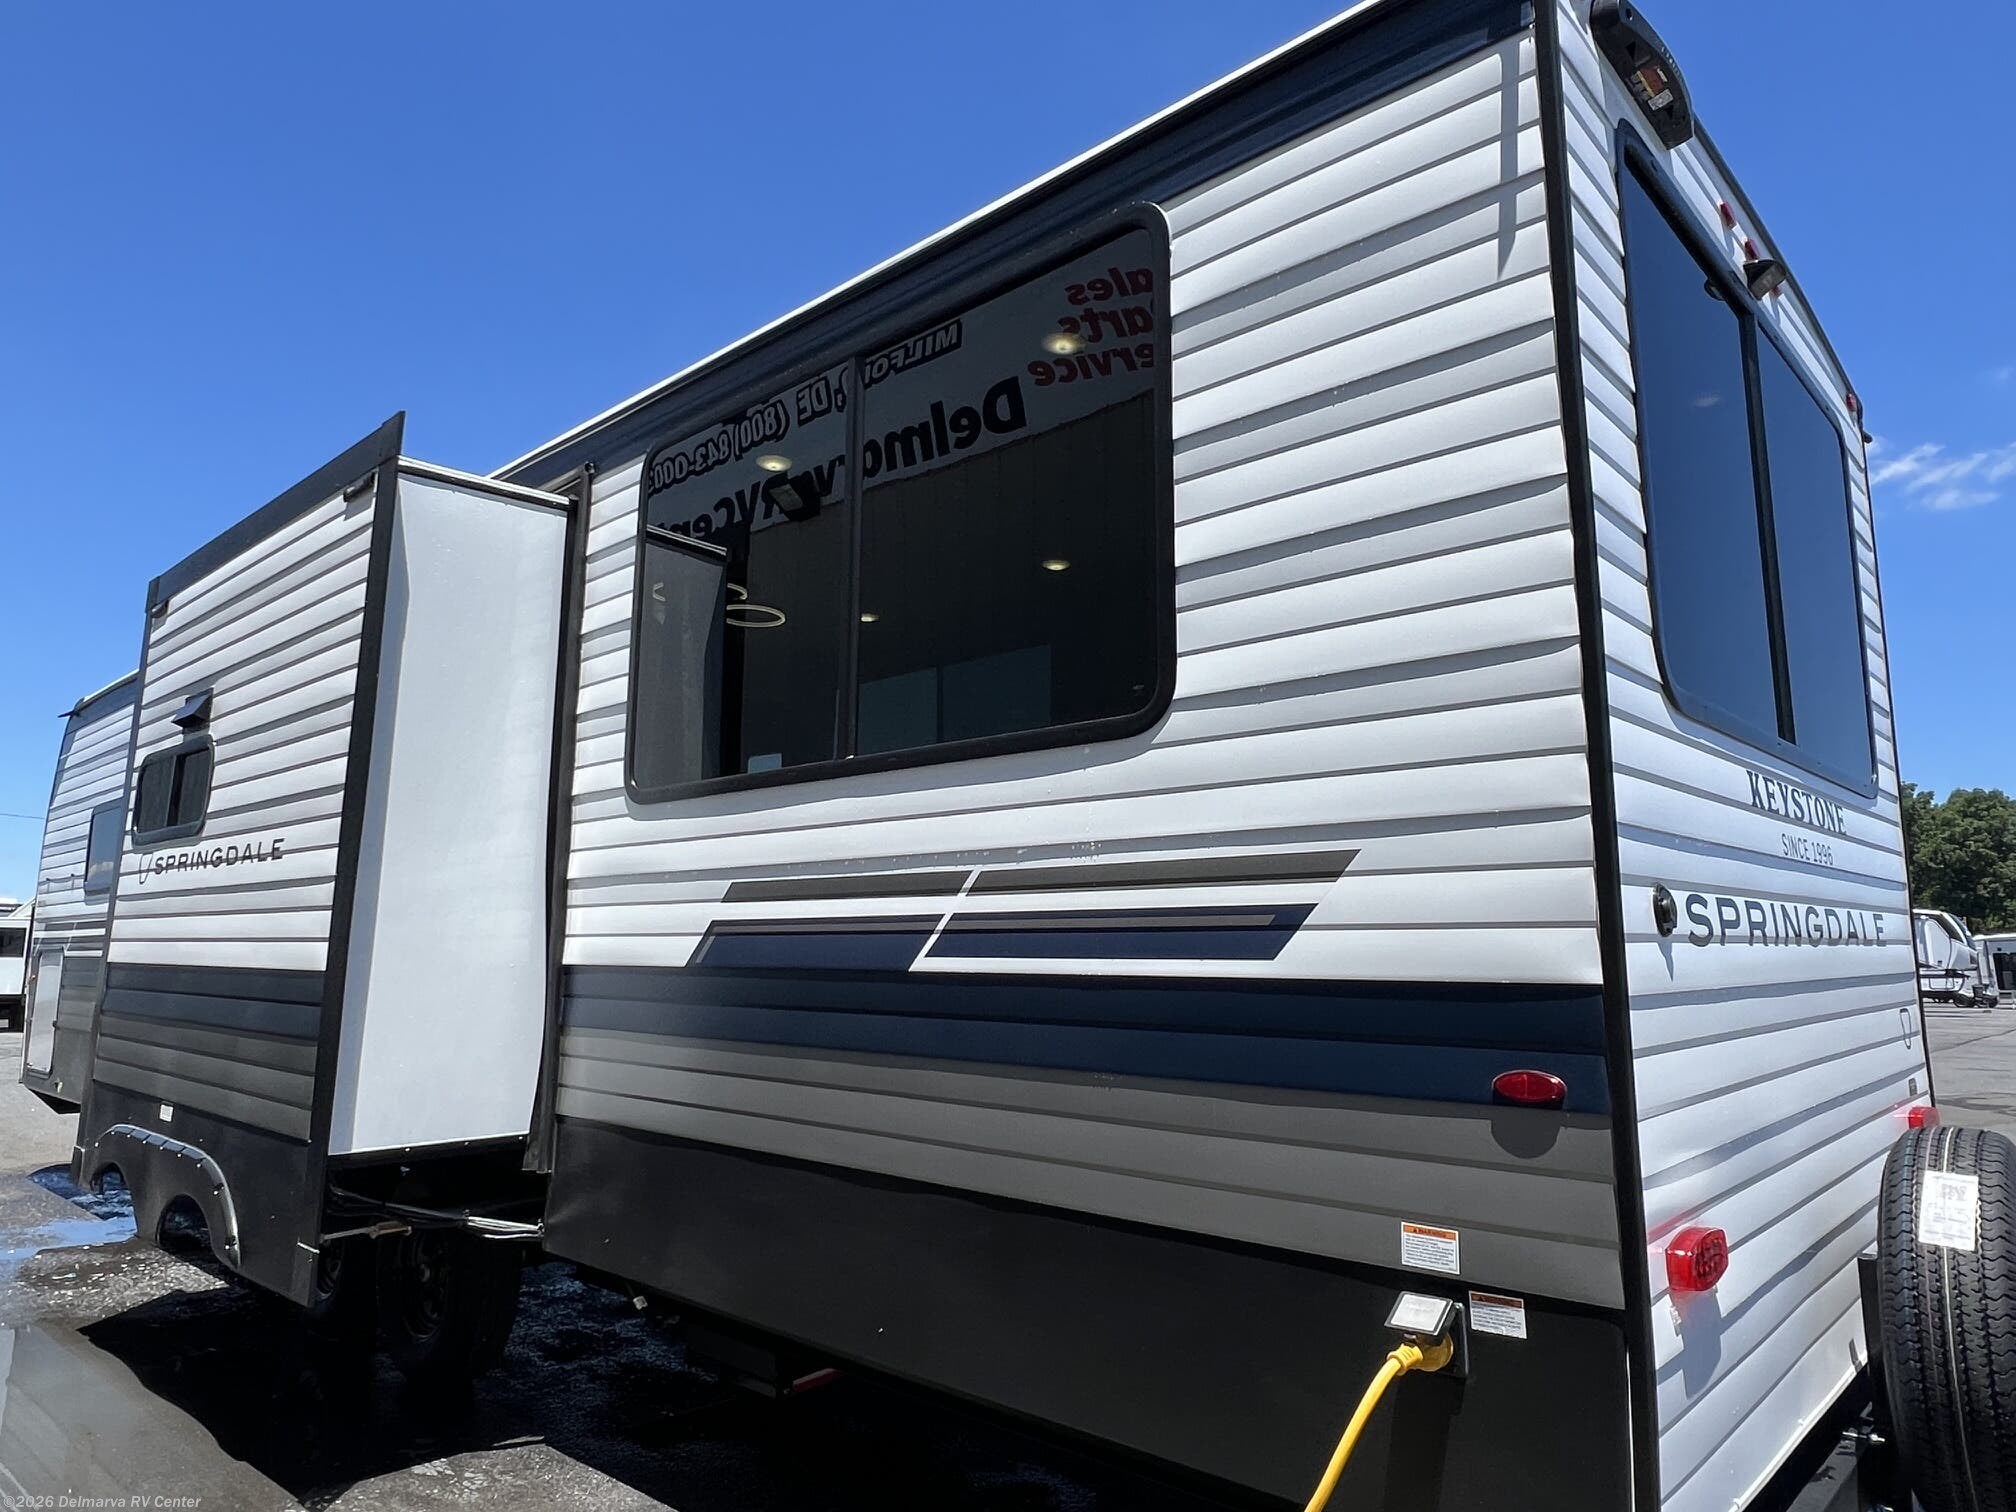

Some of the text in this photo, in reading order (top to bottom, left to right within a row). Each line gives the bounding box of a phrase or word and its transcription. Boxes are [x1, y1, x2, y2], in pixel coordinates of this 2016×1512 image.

[1746, 770, 1847, 834] KEYSTONE
[155, 838, 285, 875] SPRINGDALE
[1781, 833, 1834, 866] SINCE 1996
[1686, 894, 1887, 947] SPRINGDALE
